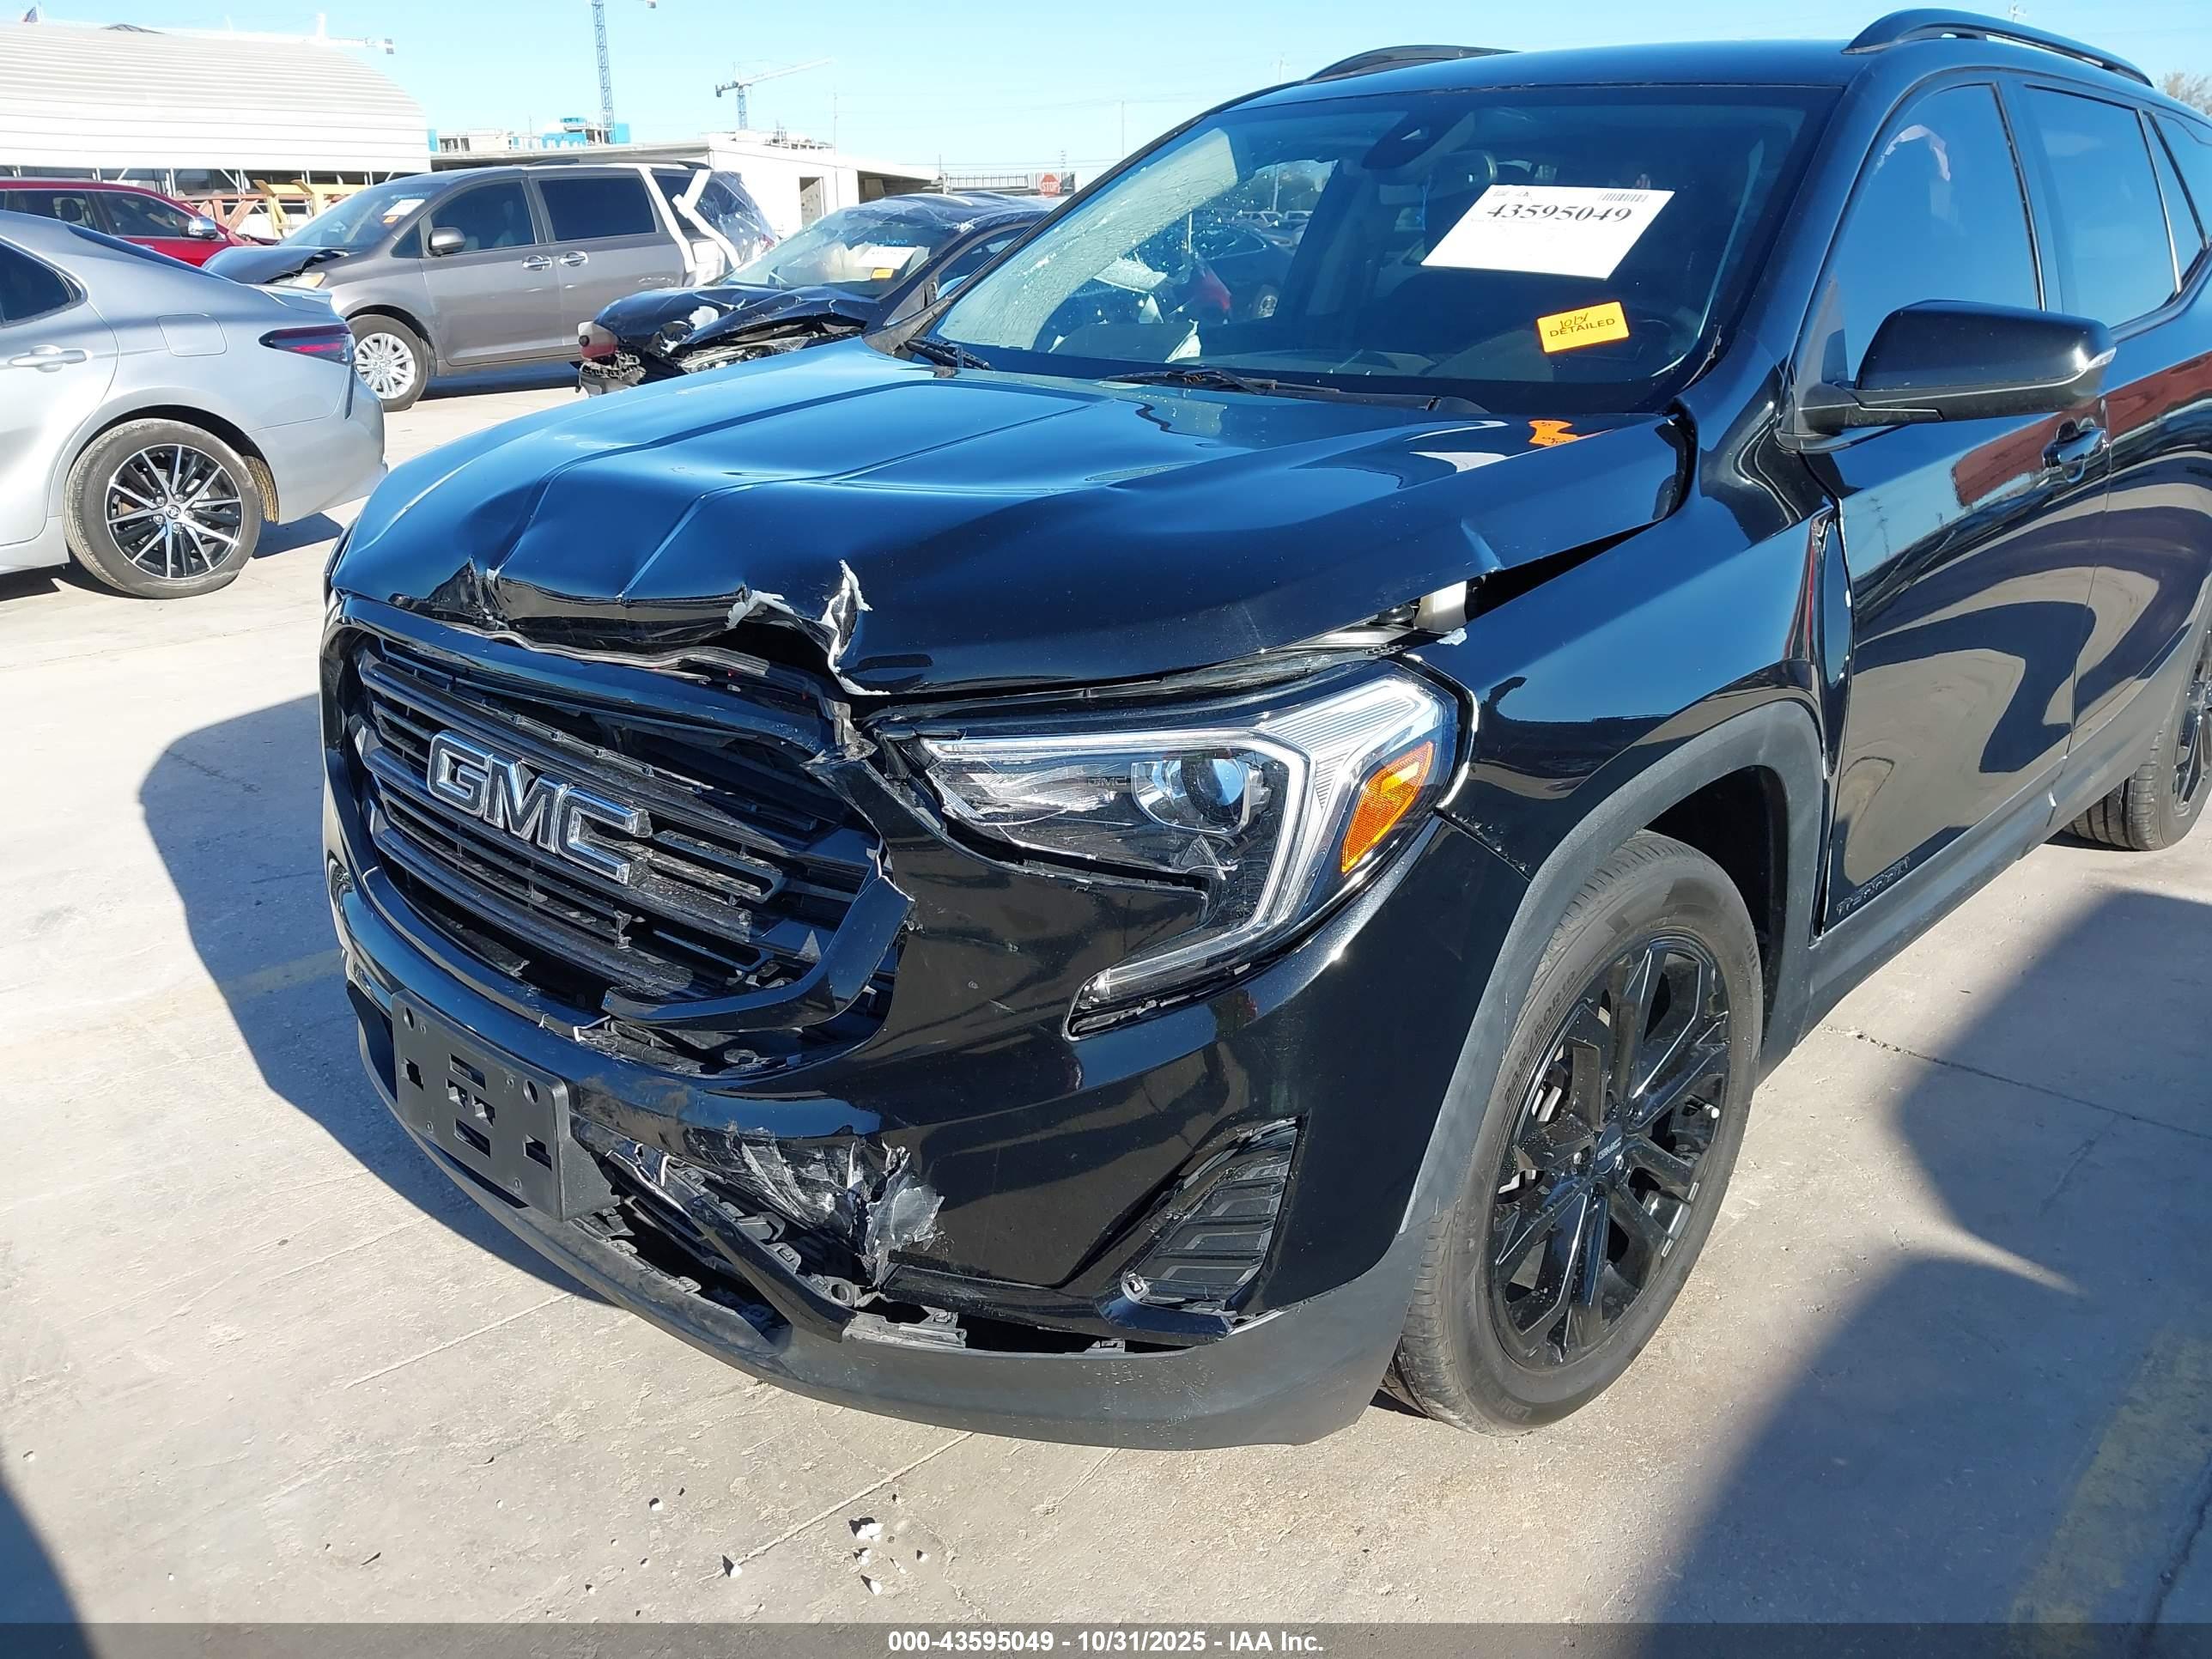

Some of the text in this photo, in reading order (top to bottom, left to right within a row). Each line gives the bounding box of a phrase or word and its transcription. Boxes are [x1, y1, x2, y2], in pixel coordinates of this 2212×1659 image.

[1042, 182, 1059, 191] STOP
[1487, 204, 1632, 222] 43595049
[1549, 318, 1615, 337] DETAILED
[427, 730, 650, 887] GMC
[1597, 1136, 1622, 1161] GMC
